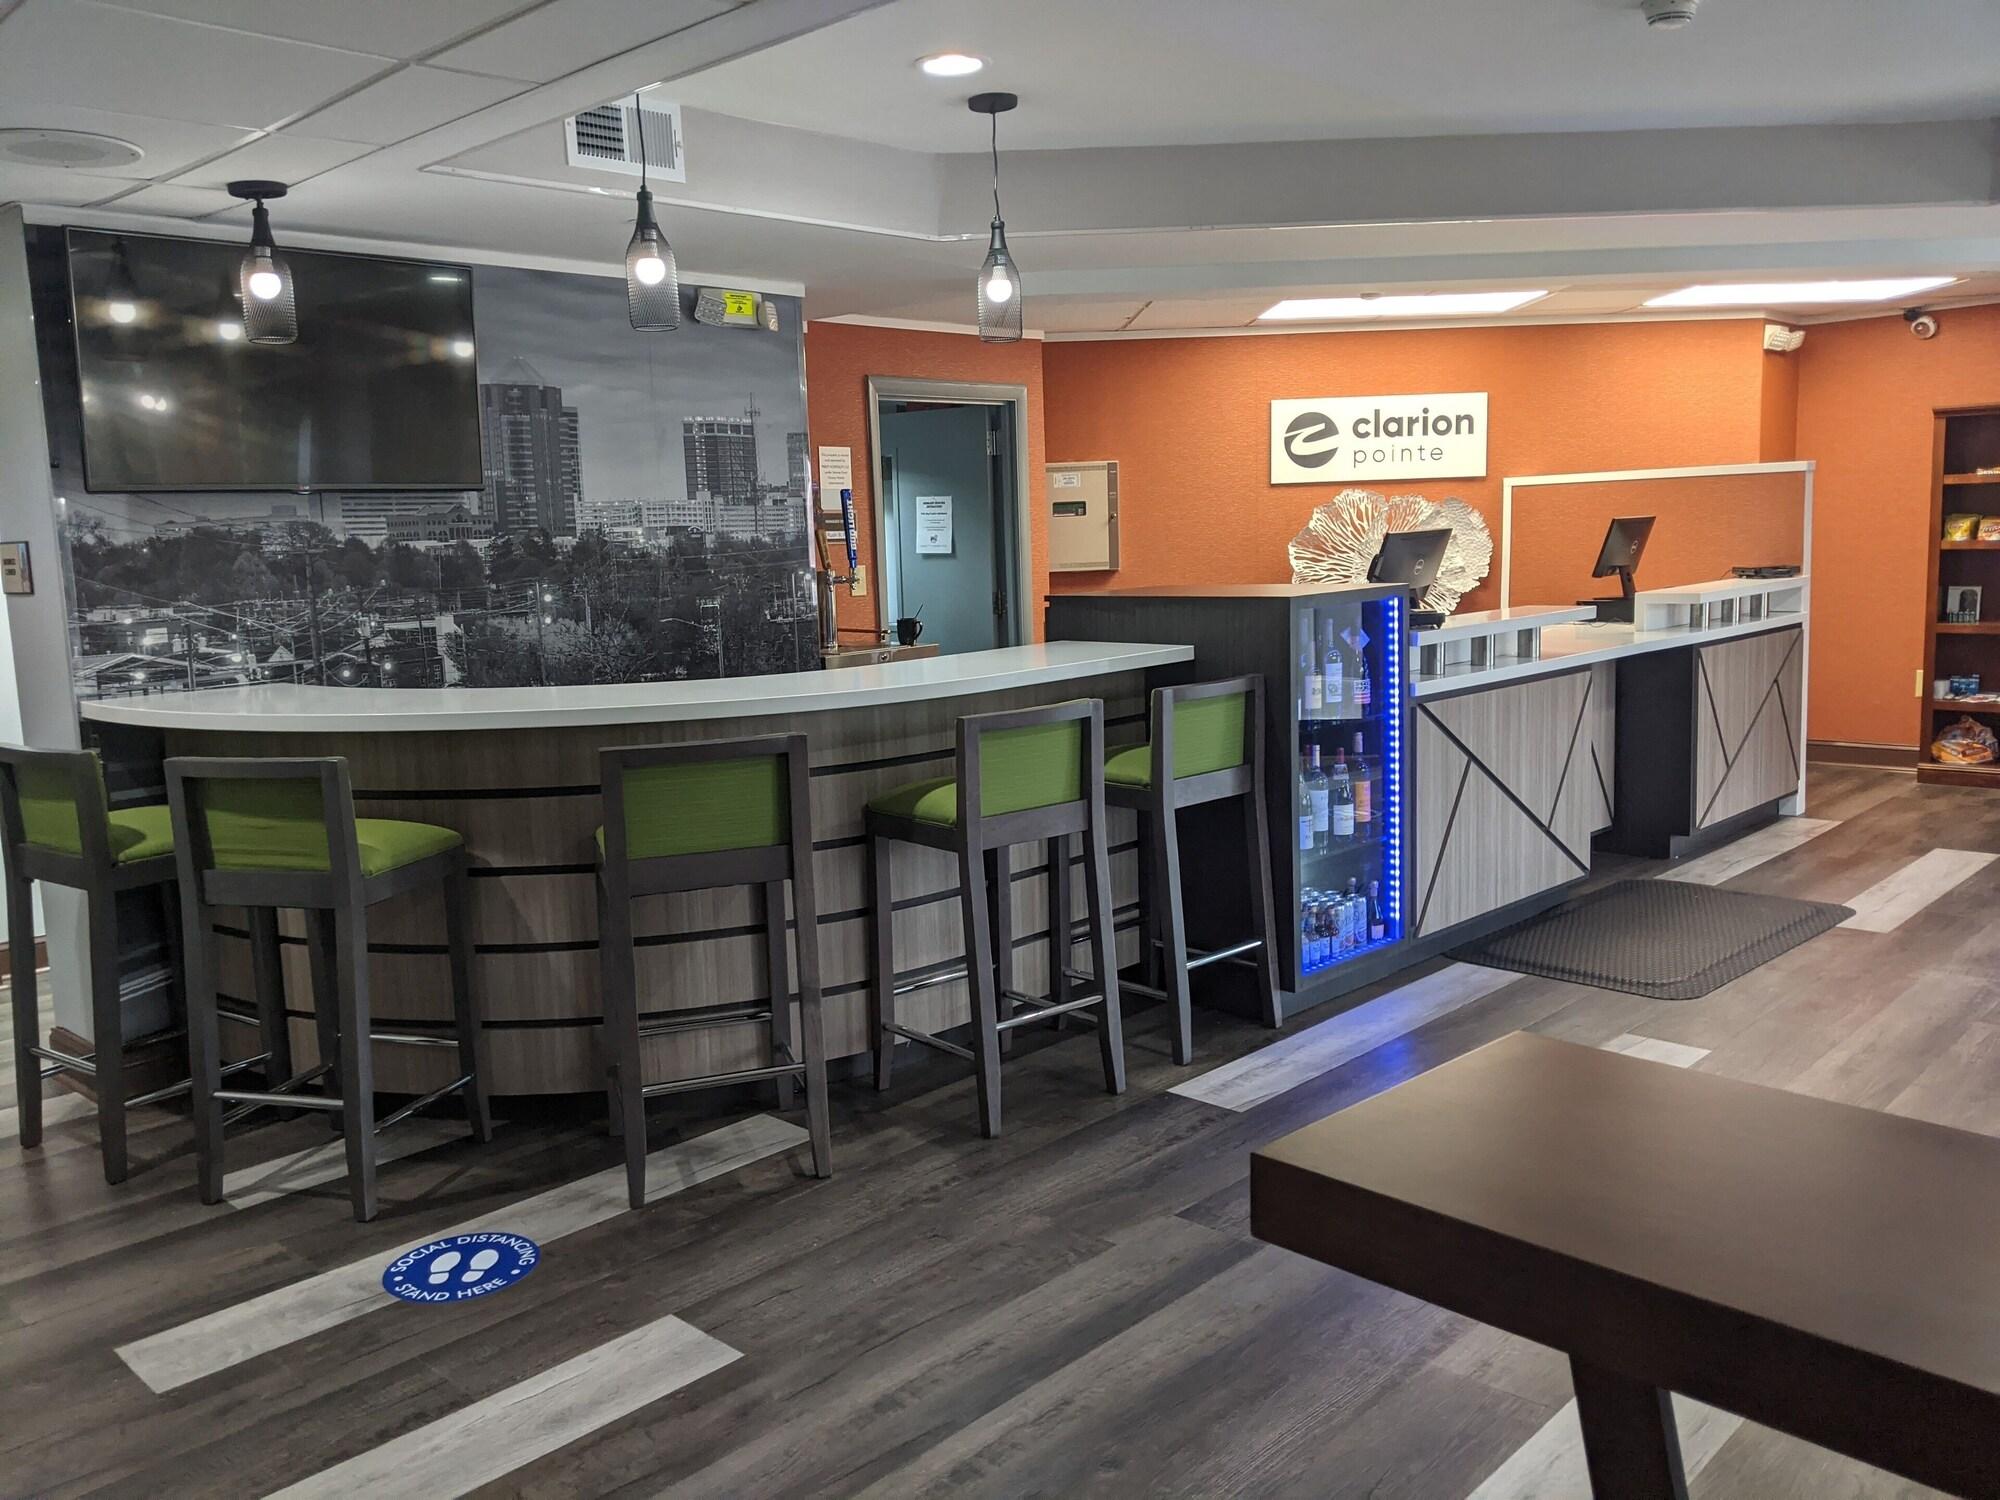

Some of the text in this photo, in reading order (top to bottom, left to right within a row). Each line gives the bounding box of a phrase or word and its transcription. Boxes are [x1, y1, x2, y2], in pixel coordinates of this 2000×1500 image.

[1352, 407, 1474, 438] clarion
[1353, 444, 1443, 468] pointe
[846, 499, 857, 550] BUD LIGHT
[391, 1234, 535, 1273] SOCIAL DISTANCING
[395, 1277, 507, 1301] STAND HERE
